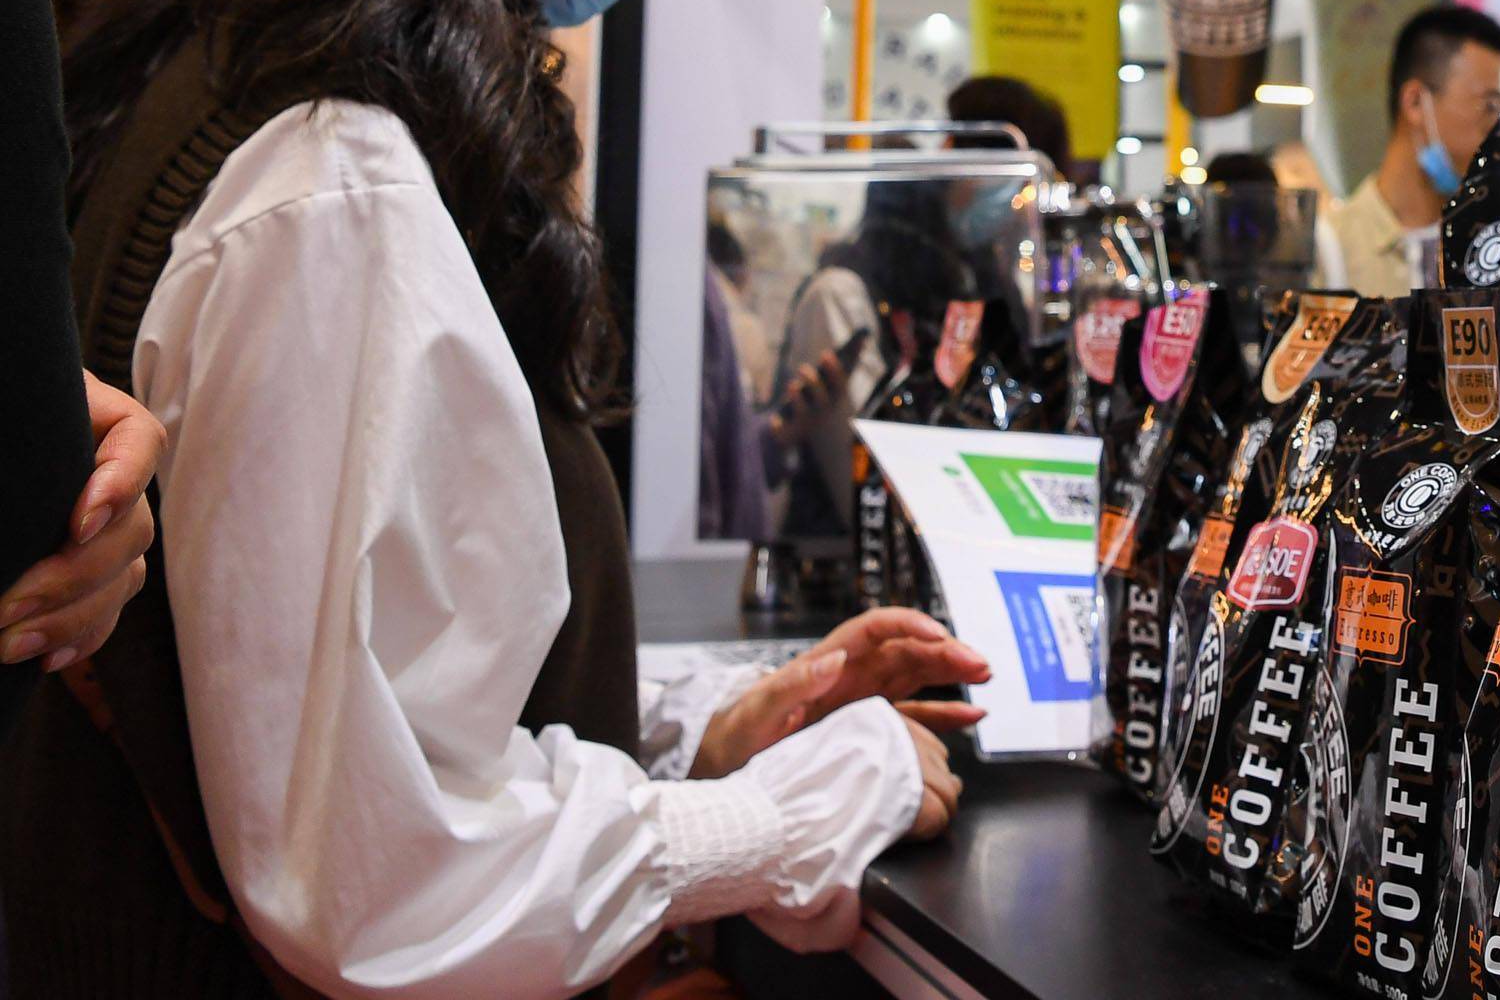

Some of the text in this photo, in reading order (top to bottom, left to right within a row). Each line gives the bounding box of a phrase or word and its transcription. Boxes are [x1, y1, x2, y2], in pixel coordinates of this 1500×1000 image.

[1450, 318, 1491, 356] E90
[1125, 584, 1162, 785] COFFEE
[1223, 616, 1318, 870] COFFEE
[1206, 783, 1230, 857] ONE
[1375, 678, 1439, 973] COFFEE
[1354, 874, 1375, 957] ONE
